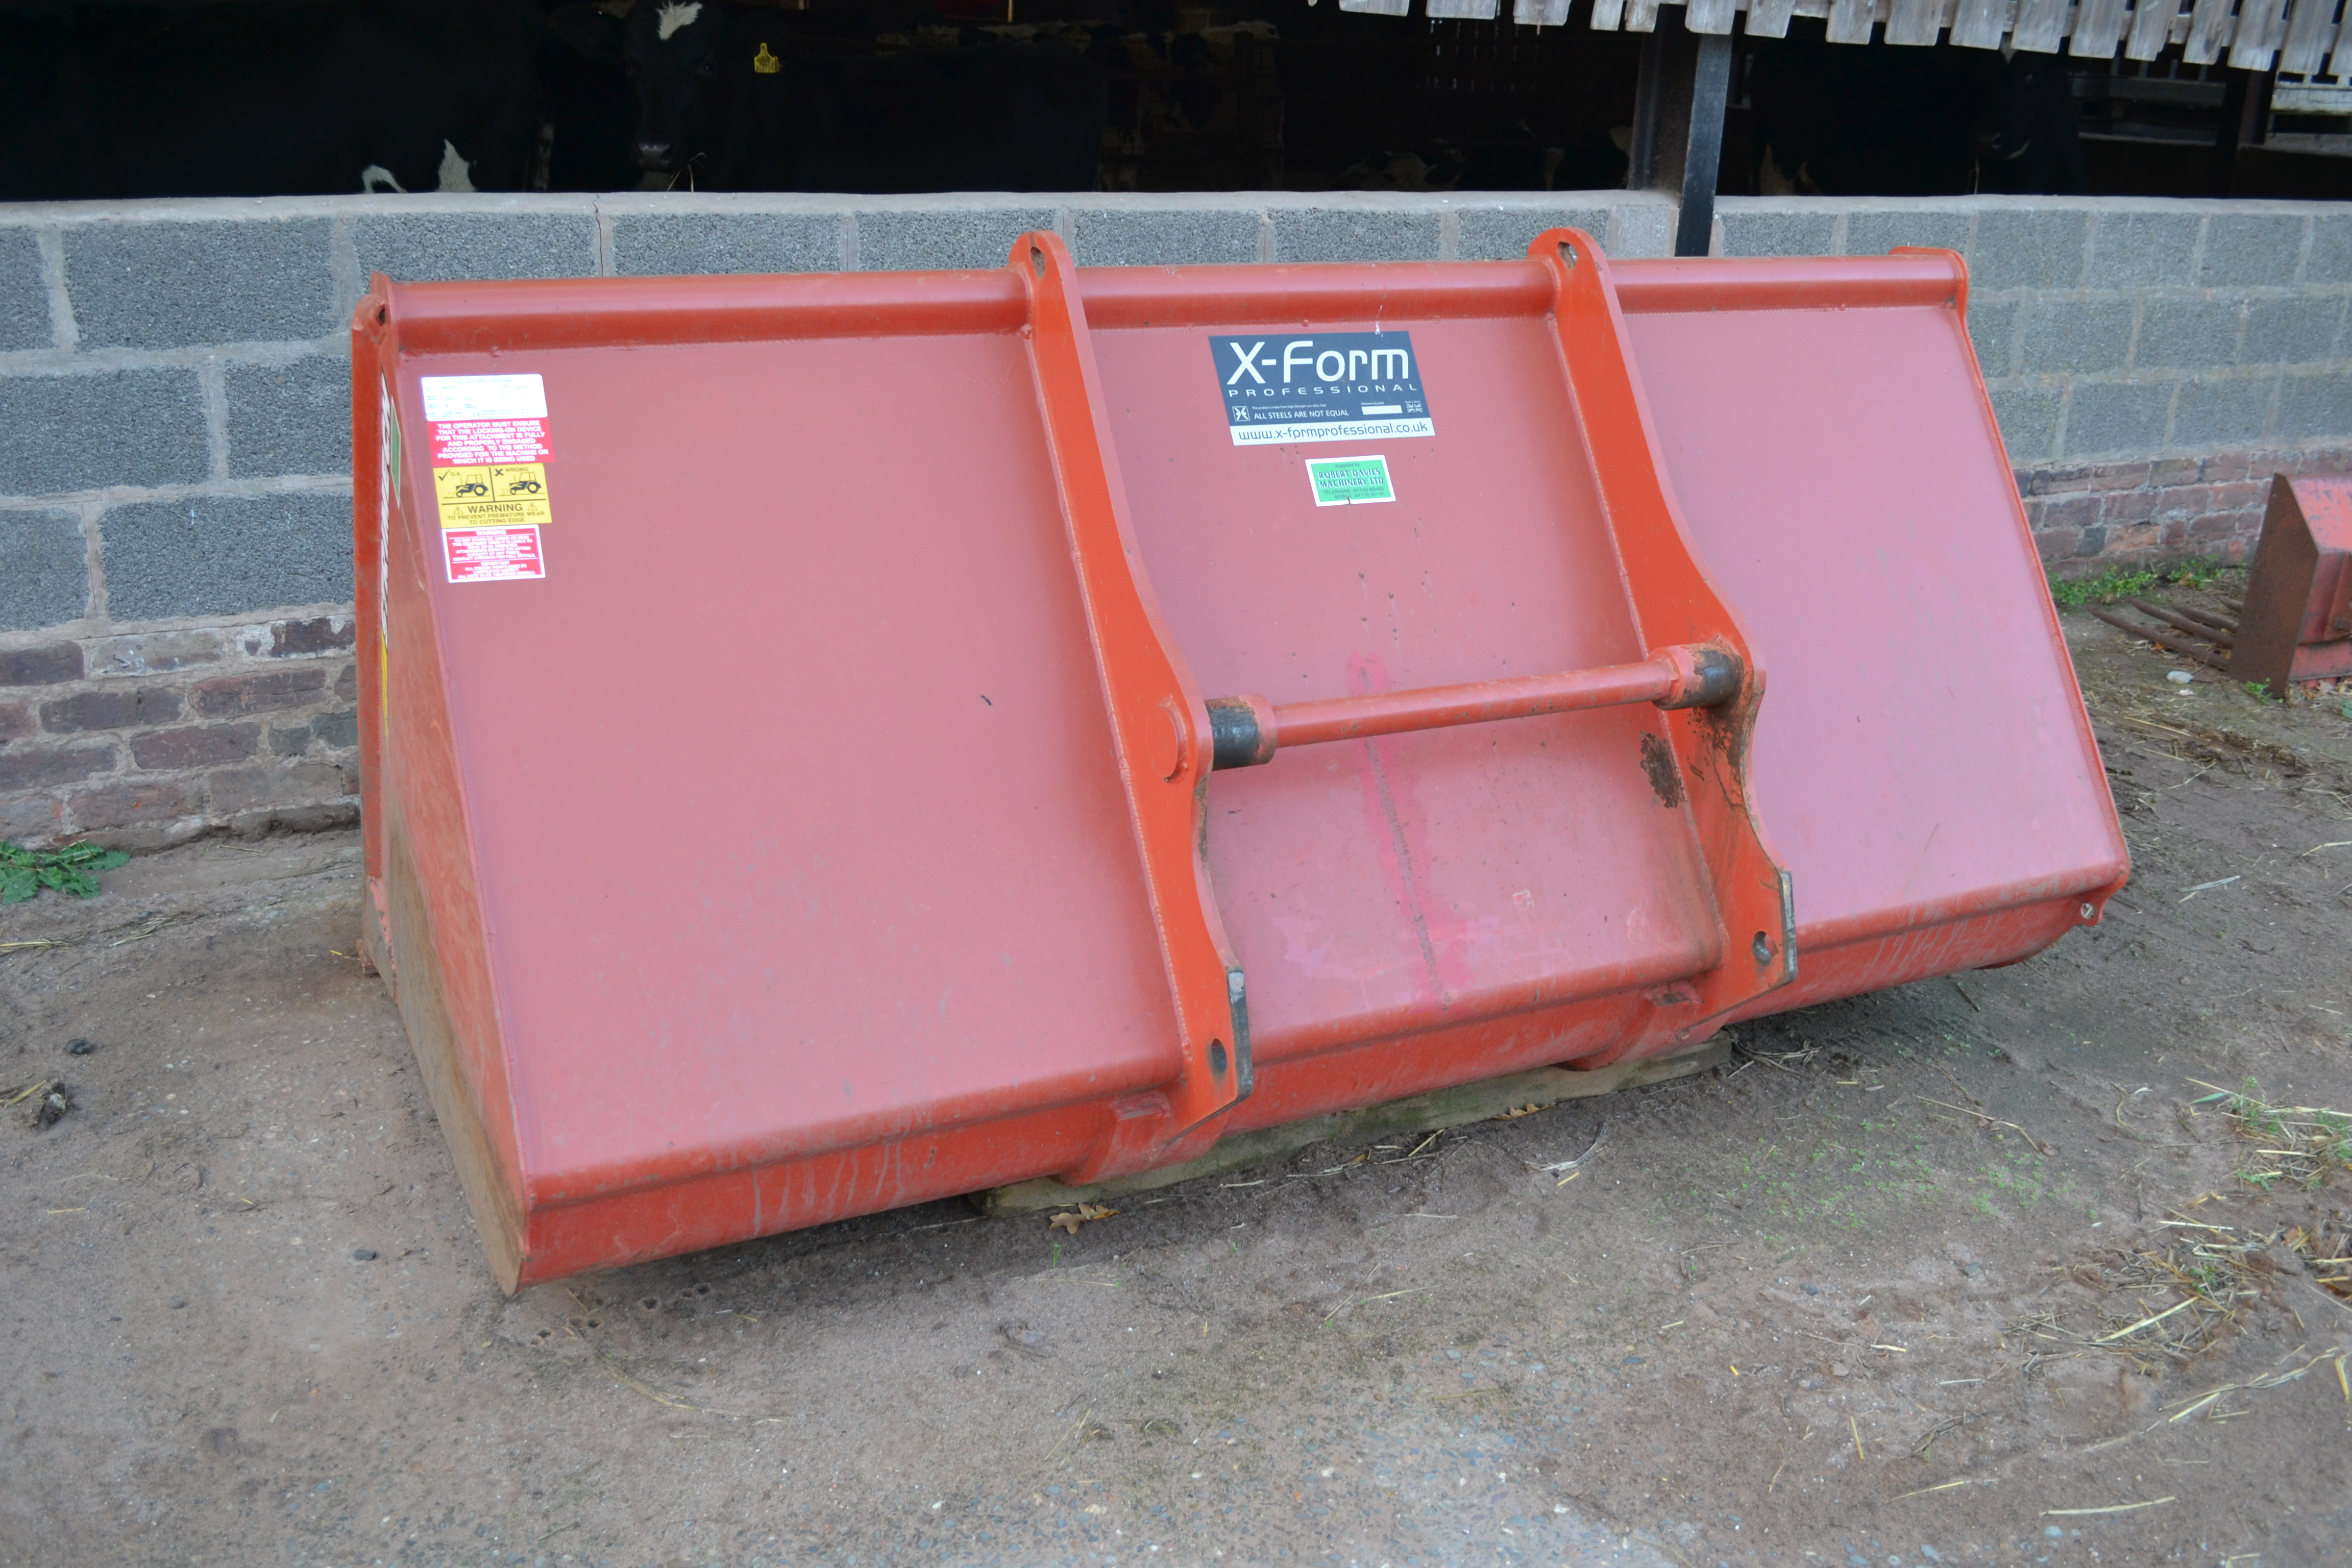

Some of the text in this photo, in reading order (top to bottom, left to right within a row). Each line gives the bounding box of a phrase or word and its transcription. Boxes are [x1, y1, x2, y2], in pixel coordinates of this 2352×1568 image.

[1228, 383, 1417, 398] PROFESSIONAL
[1238, 421, 1428, 440] www.x-formprofessional.co.uk
[1317, 468, 1381, 480] ROBERT DAVIES
[1319, 477, 1384, 489] MACHINERY LTD
[467, 503, 523, 513] WARNING
